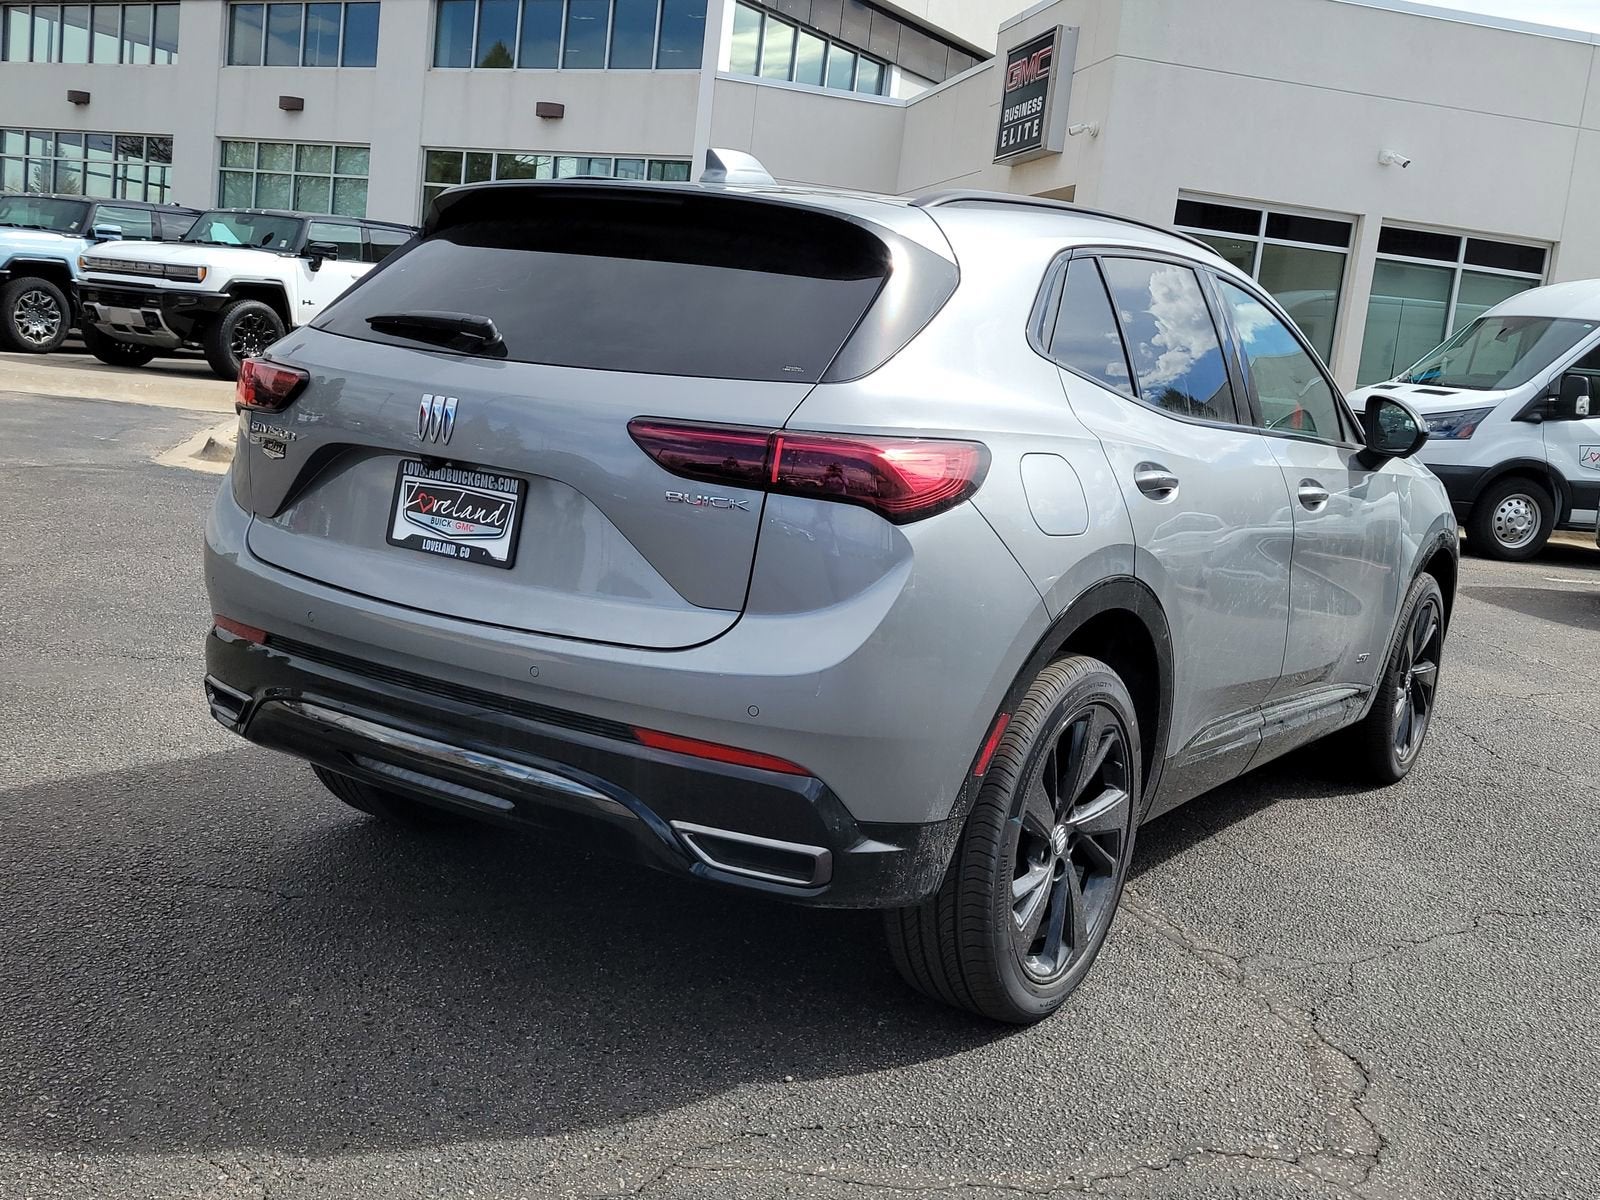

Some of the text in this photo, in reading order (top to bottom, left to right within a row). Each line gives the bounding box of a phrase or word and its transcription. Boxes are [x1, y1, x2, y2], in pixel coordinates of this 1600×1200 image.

[1006, 46, 1053, 92] GMC
[1004, 96, 1043, 123] BUSINESS
[1001, 119, 1040, 148] ELITE
[665, 490, 750, 512] BUICK
[430, 517, 475, 533] BUICK GMC
[459, 547, 470, 559] CO
